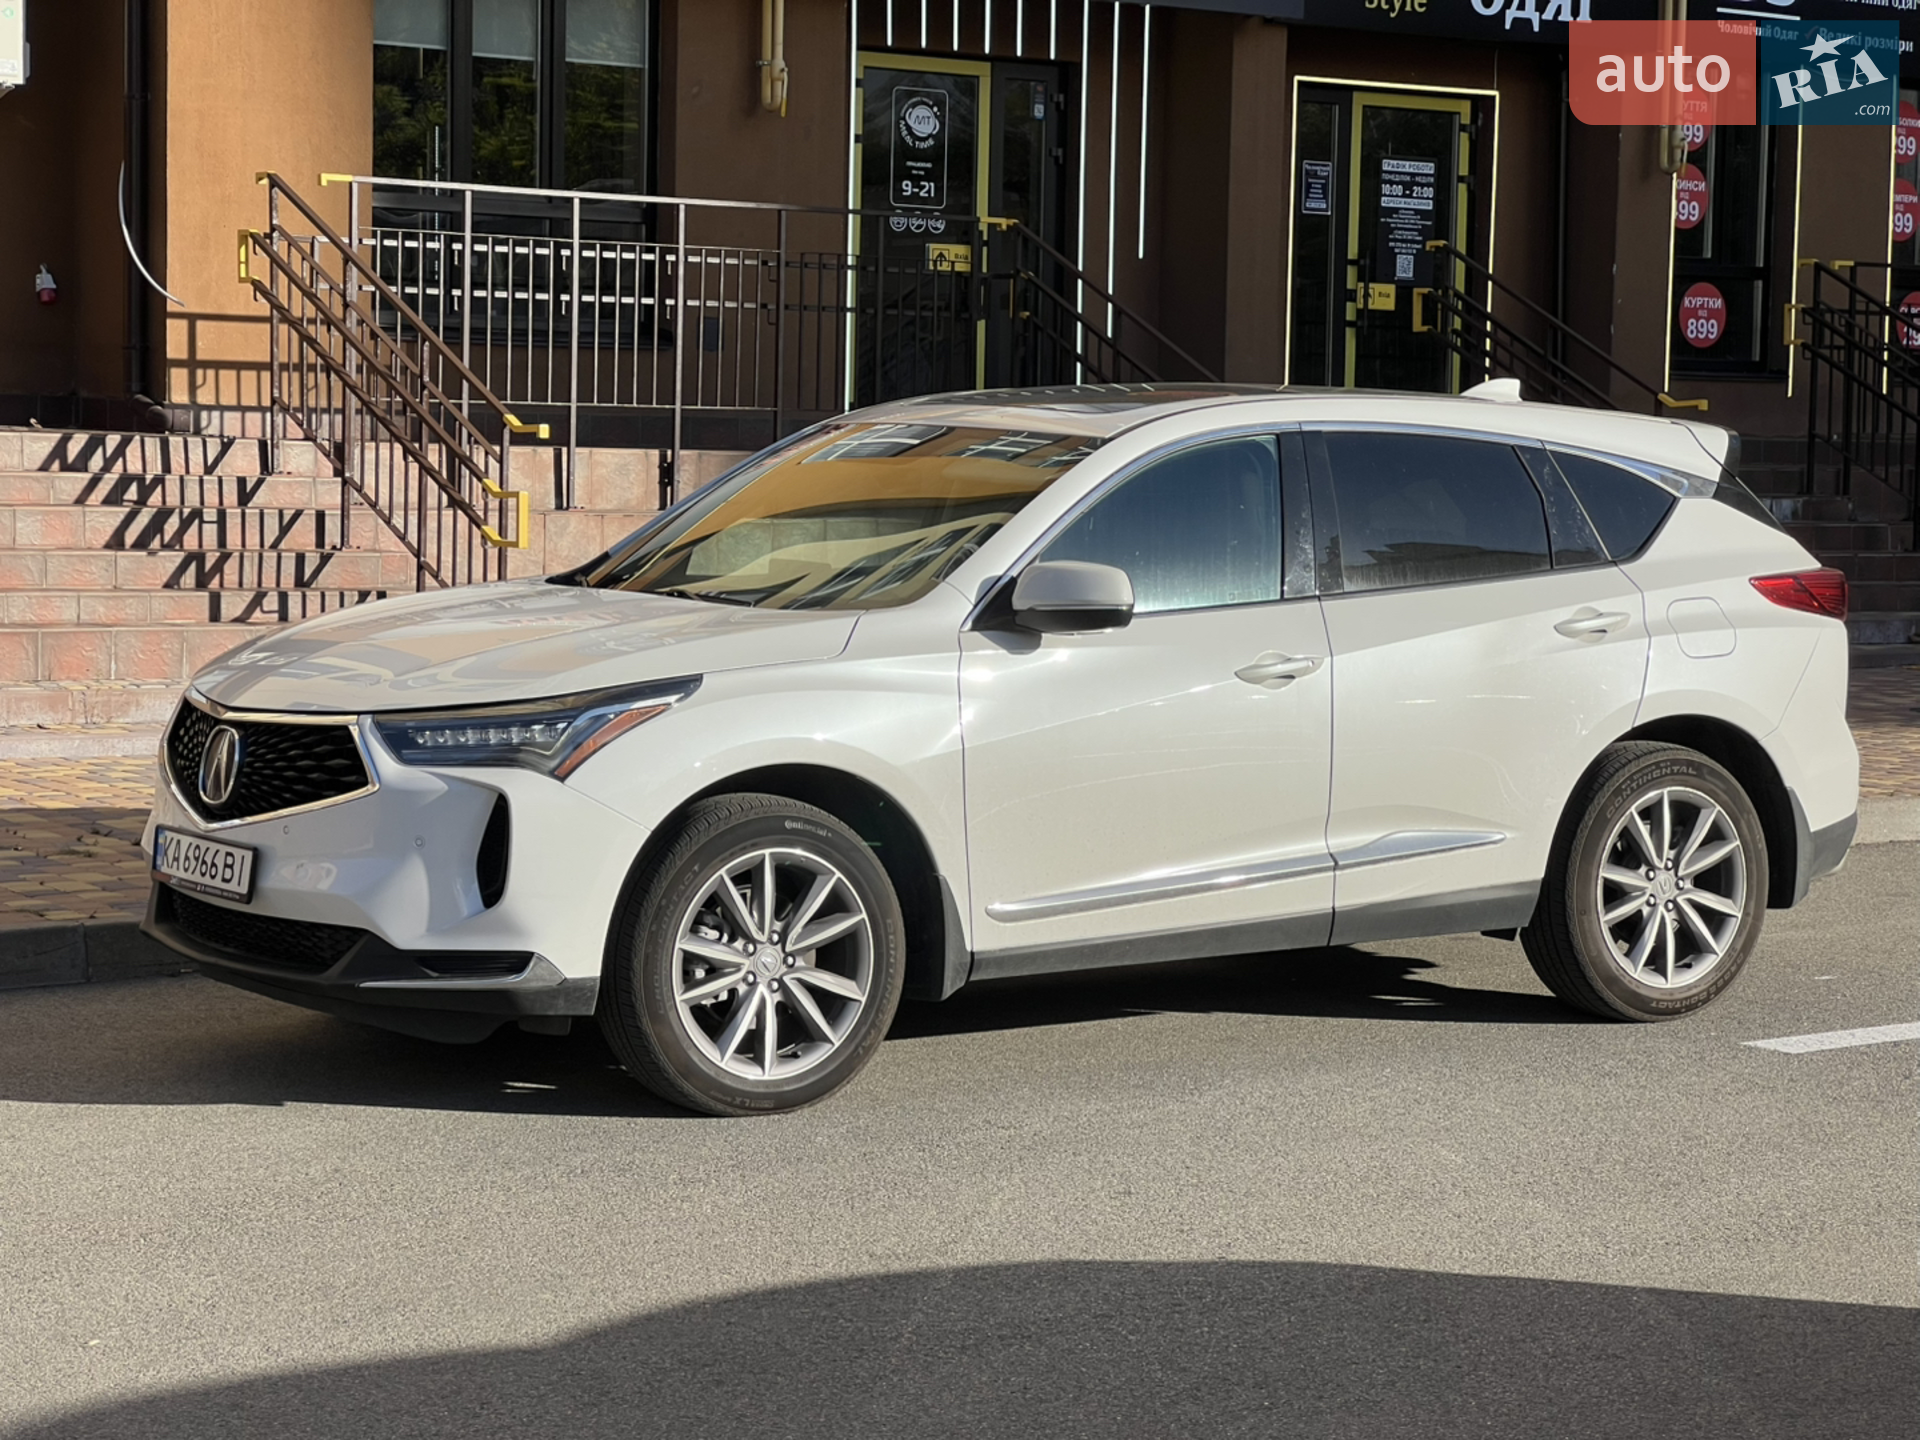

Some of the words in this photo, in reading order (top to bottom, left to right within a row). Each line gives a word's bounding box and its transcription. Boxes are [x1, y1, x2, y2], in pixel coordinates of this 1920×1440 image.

[1683, 122, 1704, 143] 99
[1897, 135, 1916, 156] 99
[902, 180, 934, 197] 9-21
[1381, 184, 1403, 196] 10:00
[1412, 186, 1434, 198] 21:00
[1677, 200, 1699, 221] 99
[1894, 212, 1913, 233] 99
[1684, 297, 1722, 309] КУРТКИ
[1687, 318, 1718, 339] 899
